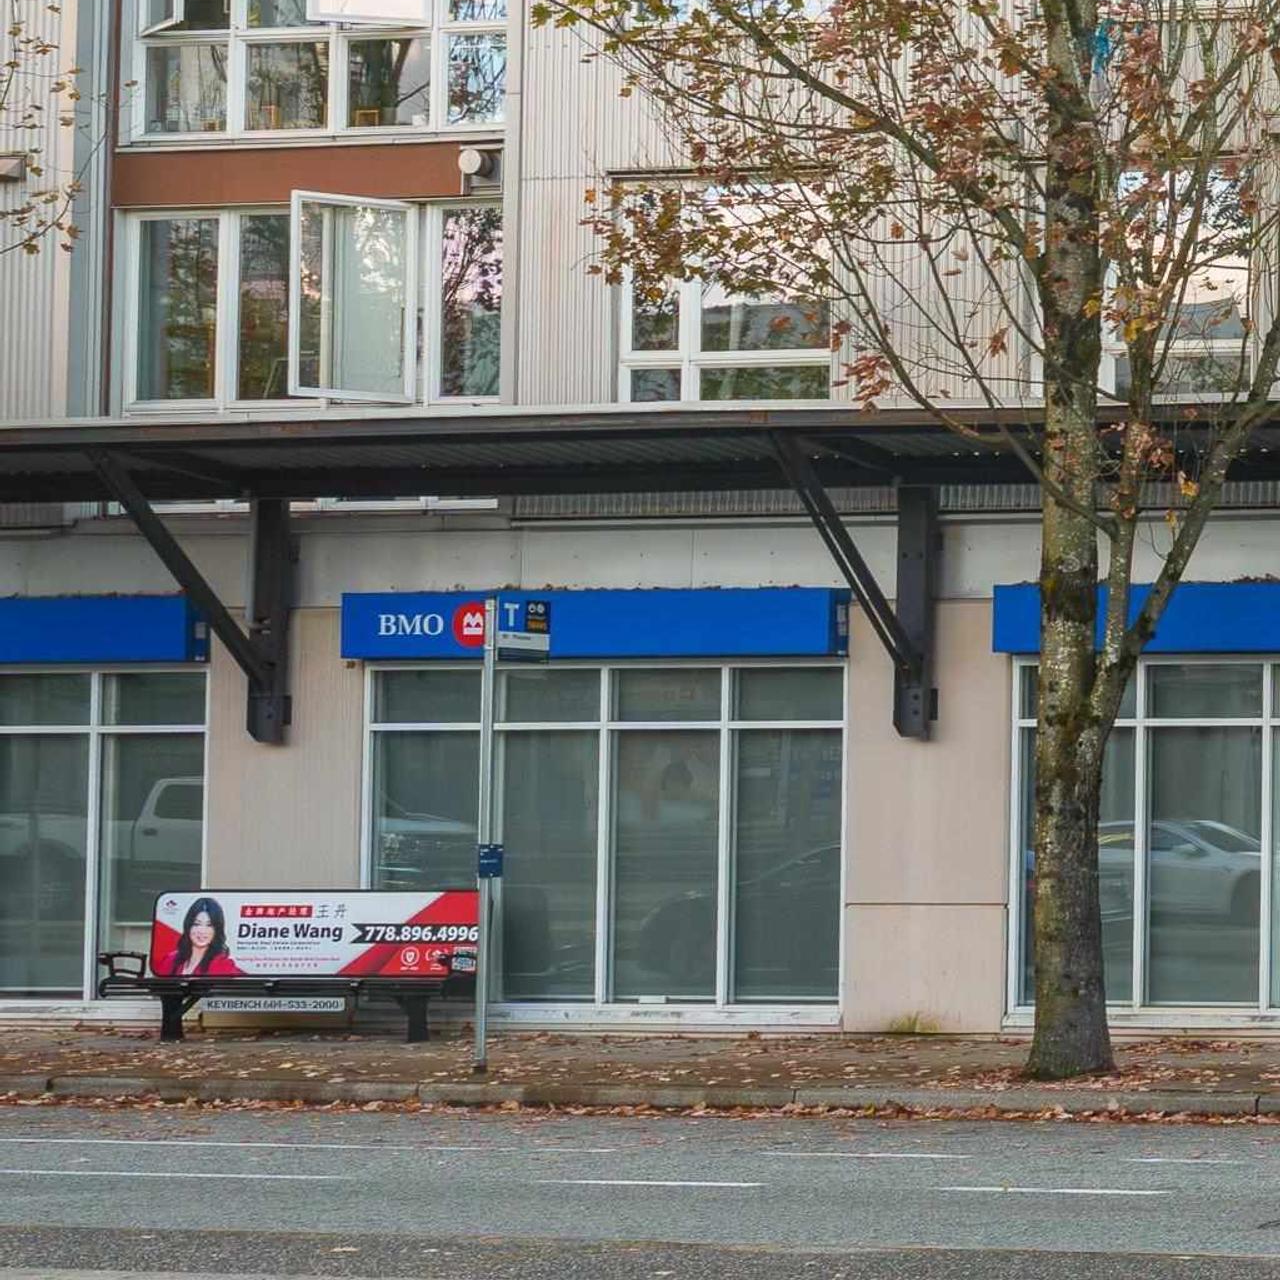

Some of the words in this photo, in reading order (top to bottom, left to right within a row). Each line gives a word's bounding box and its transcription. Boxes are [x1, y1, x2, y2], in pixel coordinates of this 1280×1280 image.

[377, 613, 444, 636] BMO
[237, 924, 289, 939] Diane
[294, 924, 343, 942] Wang
[364, 926, 479, 942] 778.896.4996
[207, 1000, 261, 1009] KEYBENCH
